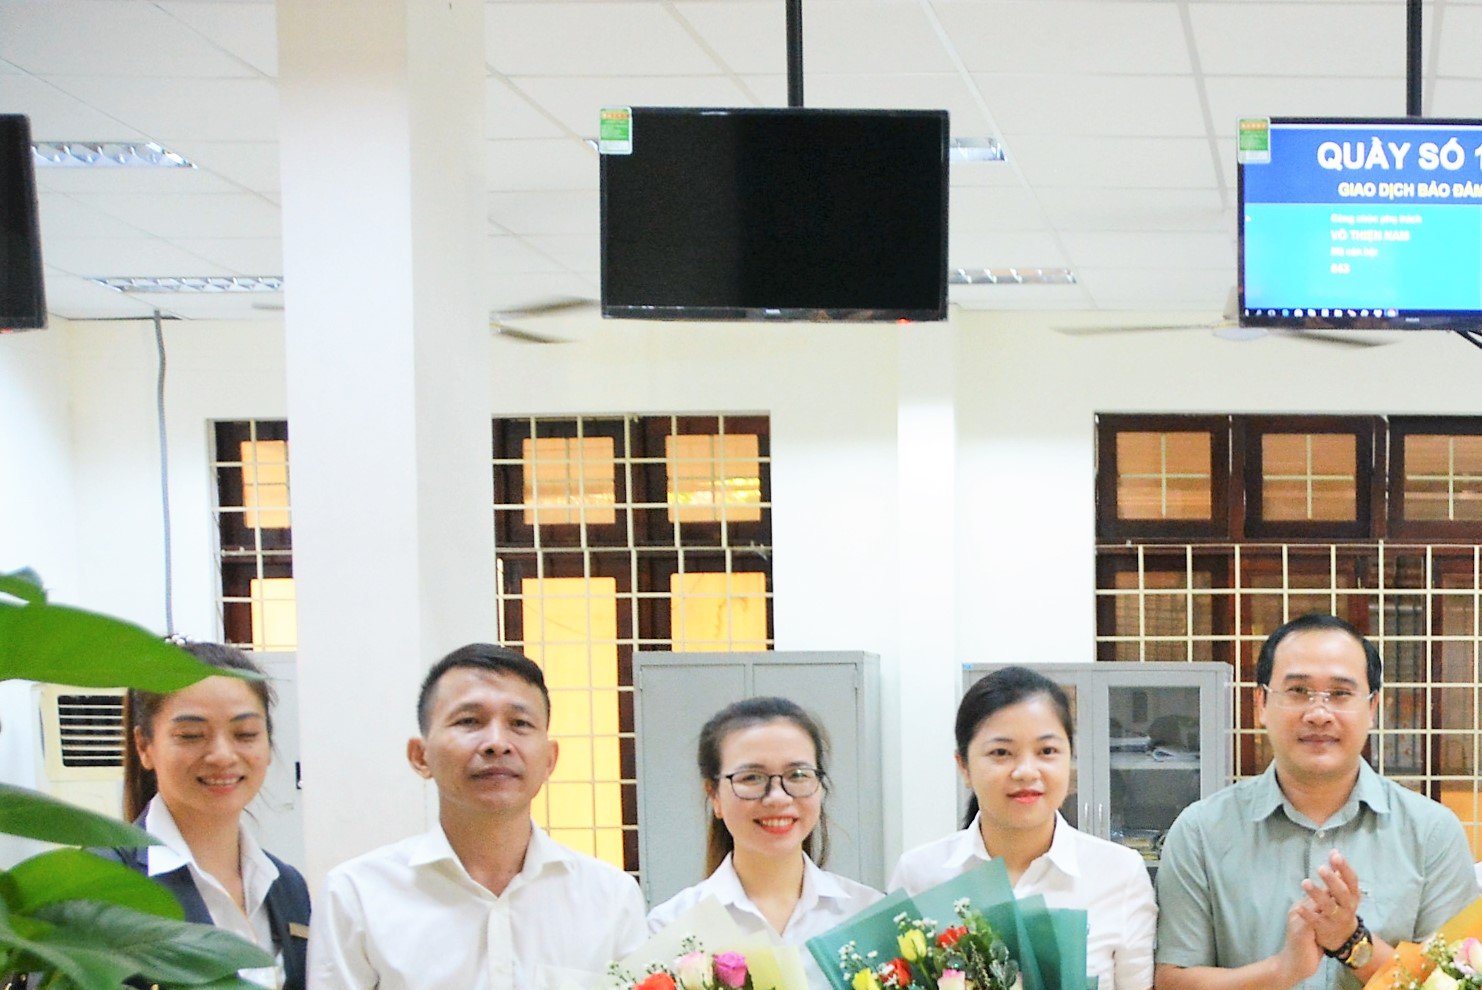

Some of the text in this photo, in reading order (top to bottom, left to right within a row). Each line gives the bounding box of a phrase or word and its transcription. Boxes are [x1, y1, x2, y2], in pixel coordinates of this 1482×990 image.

[1317, 136, 1411, 171] QUẦY
[1338, 182, 1376, 197] GIAO
[1379, 182, 1415, 200] DỊCH
